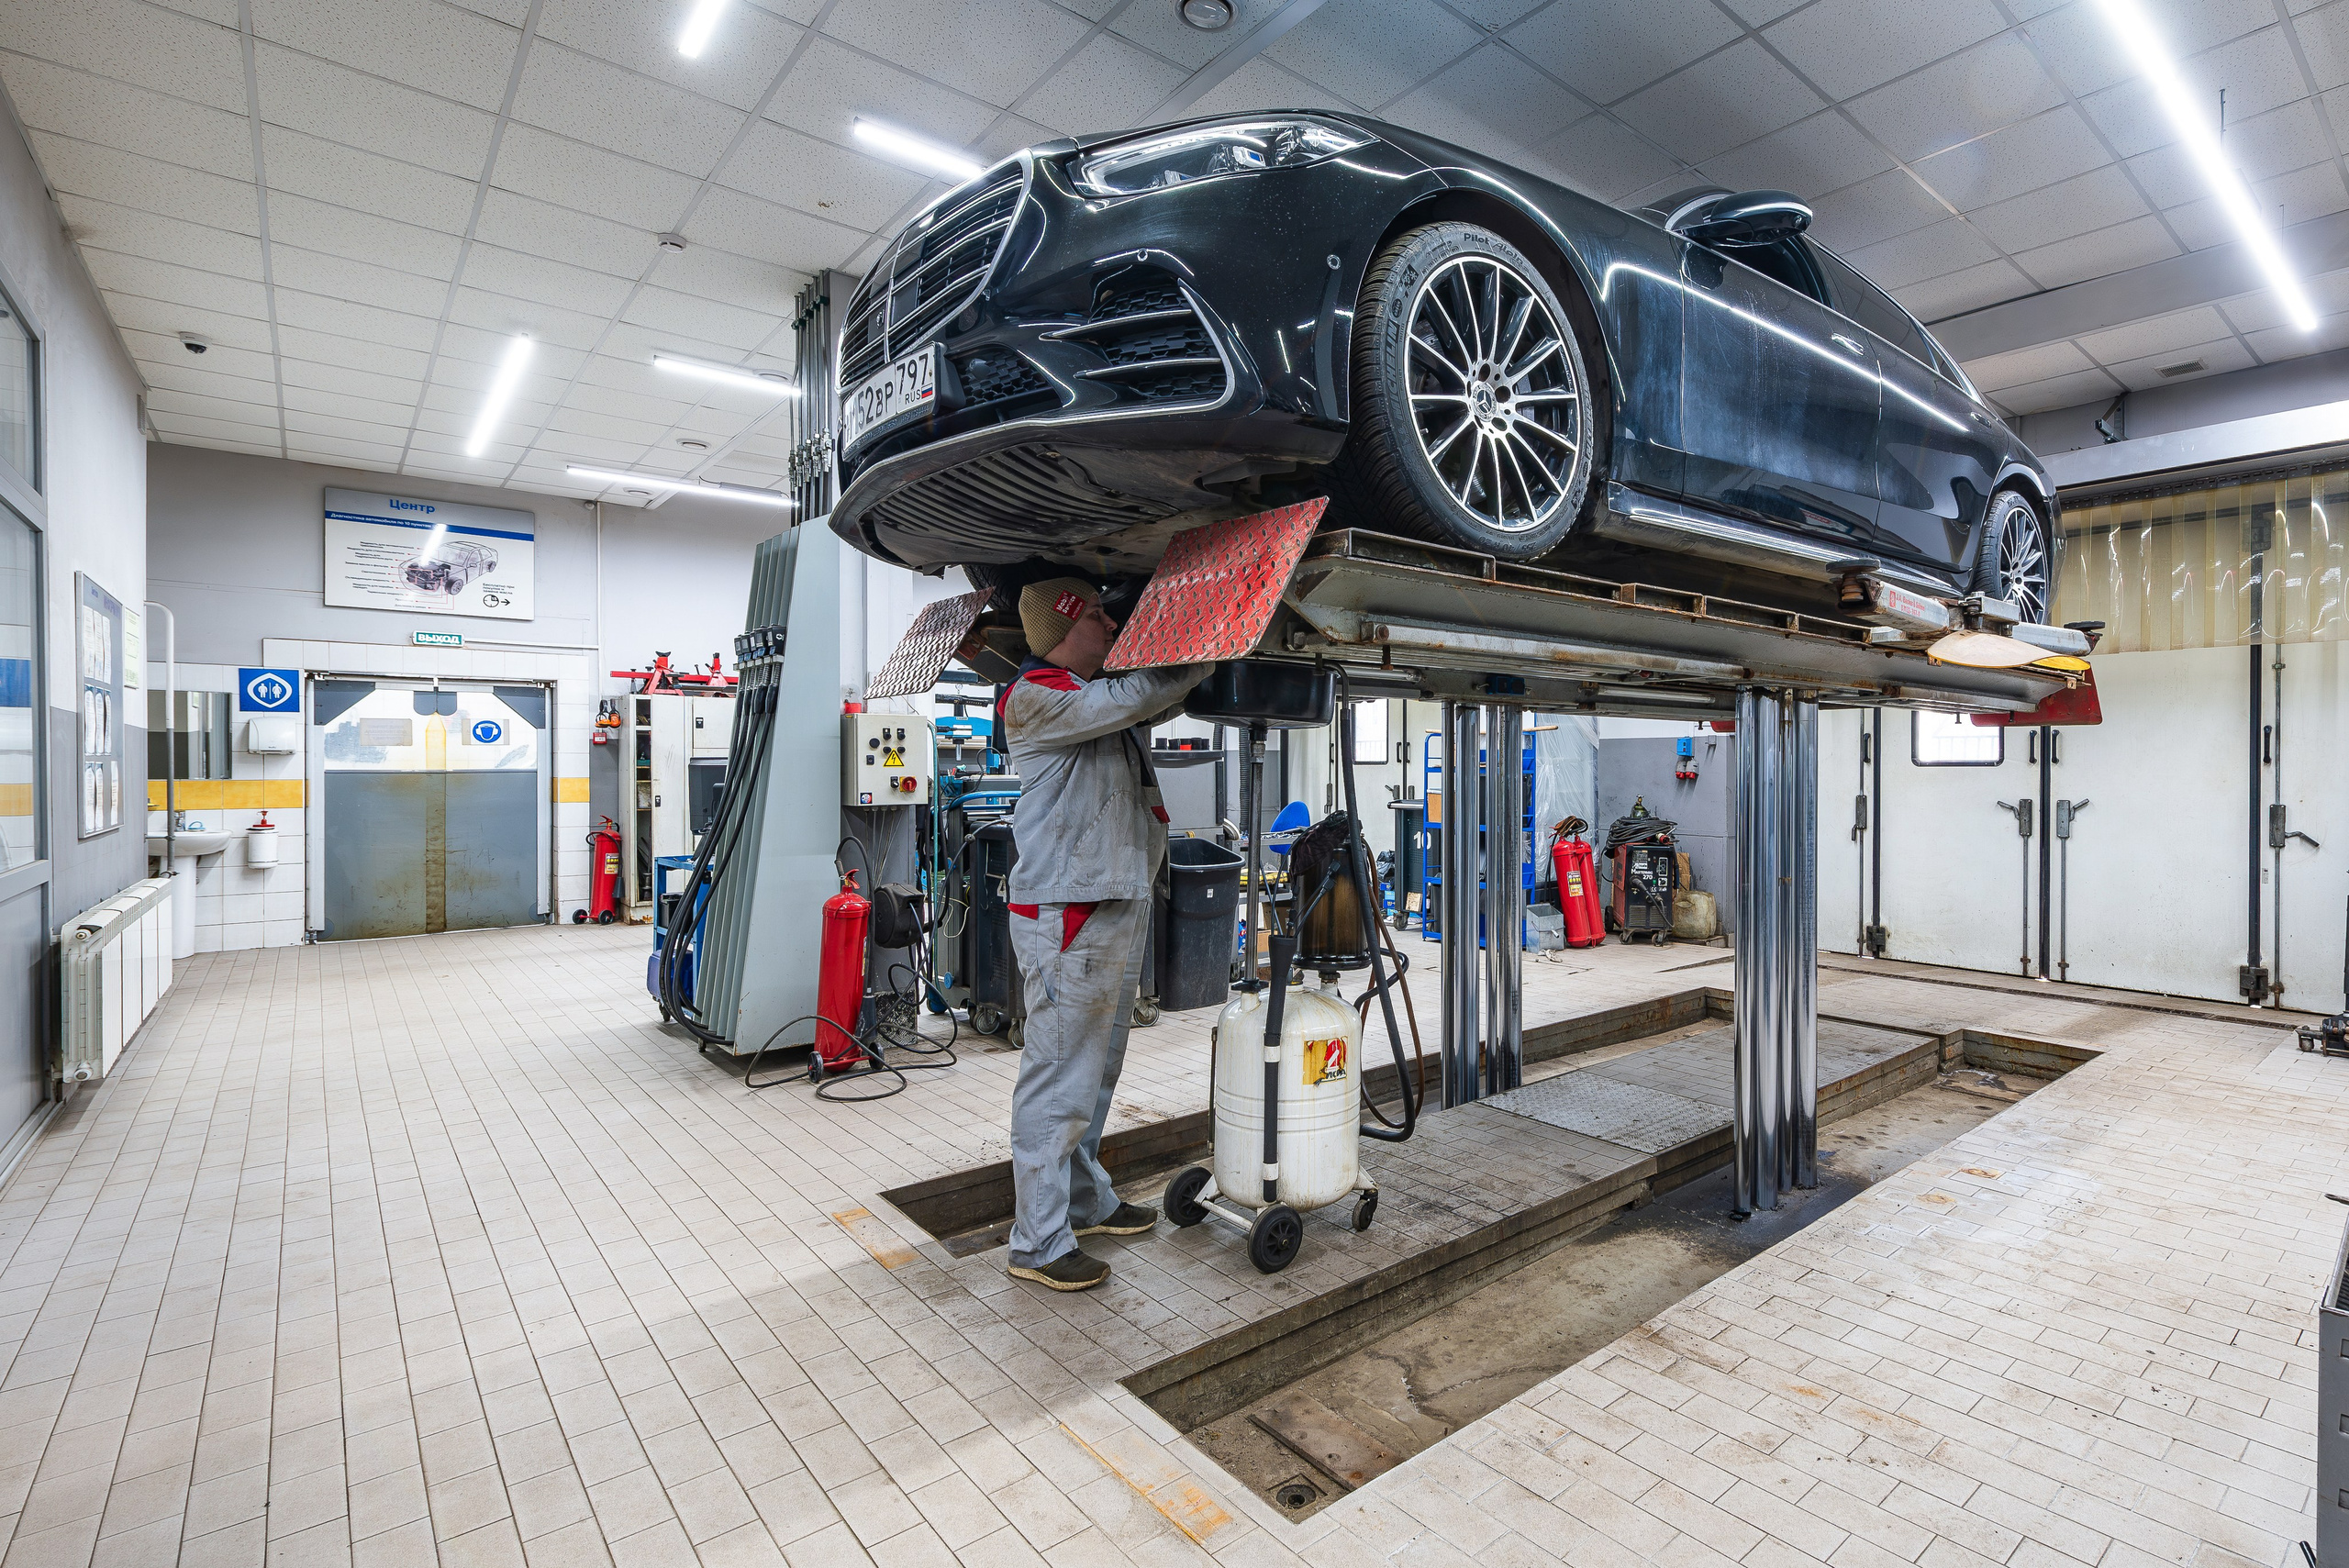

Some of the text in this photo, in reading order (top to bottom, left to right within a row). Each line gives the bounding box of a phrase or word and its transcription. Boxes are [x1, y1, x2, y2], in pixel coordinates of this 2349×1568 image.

[1464, 233, 1489, 245] Pilot
[896, 353, 929, 395] 797
[1386, 320, 1403, 421] MICHELIN
[905, 389, 921, 406] RUS
[389, 498, 436, 515] Центр
[417, 633, 461, 644] ВЫХОД
[1413, 830, 1431, 850] 10
